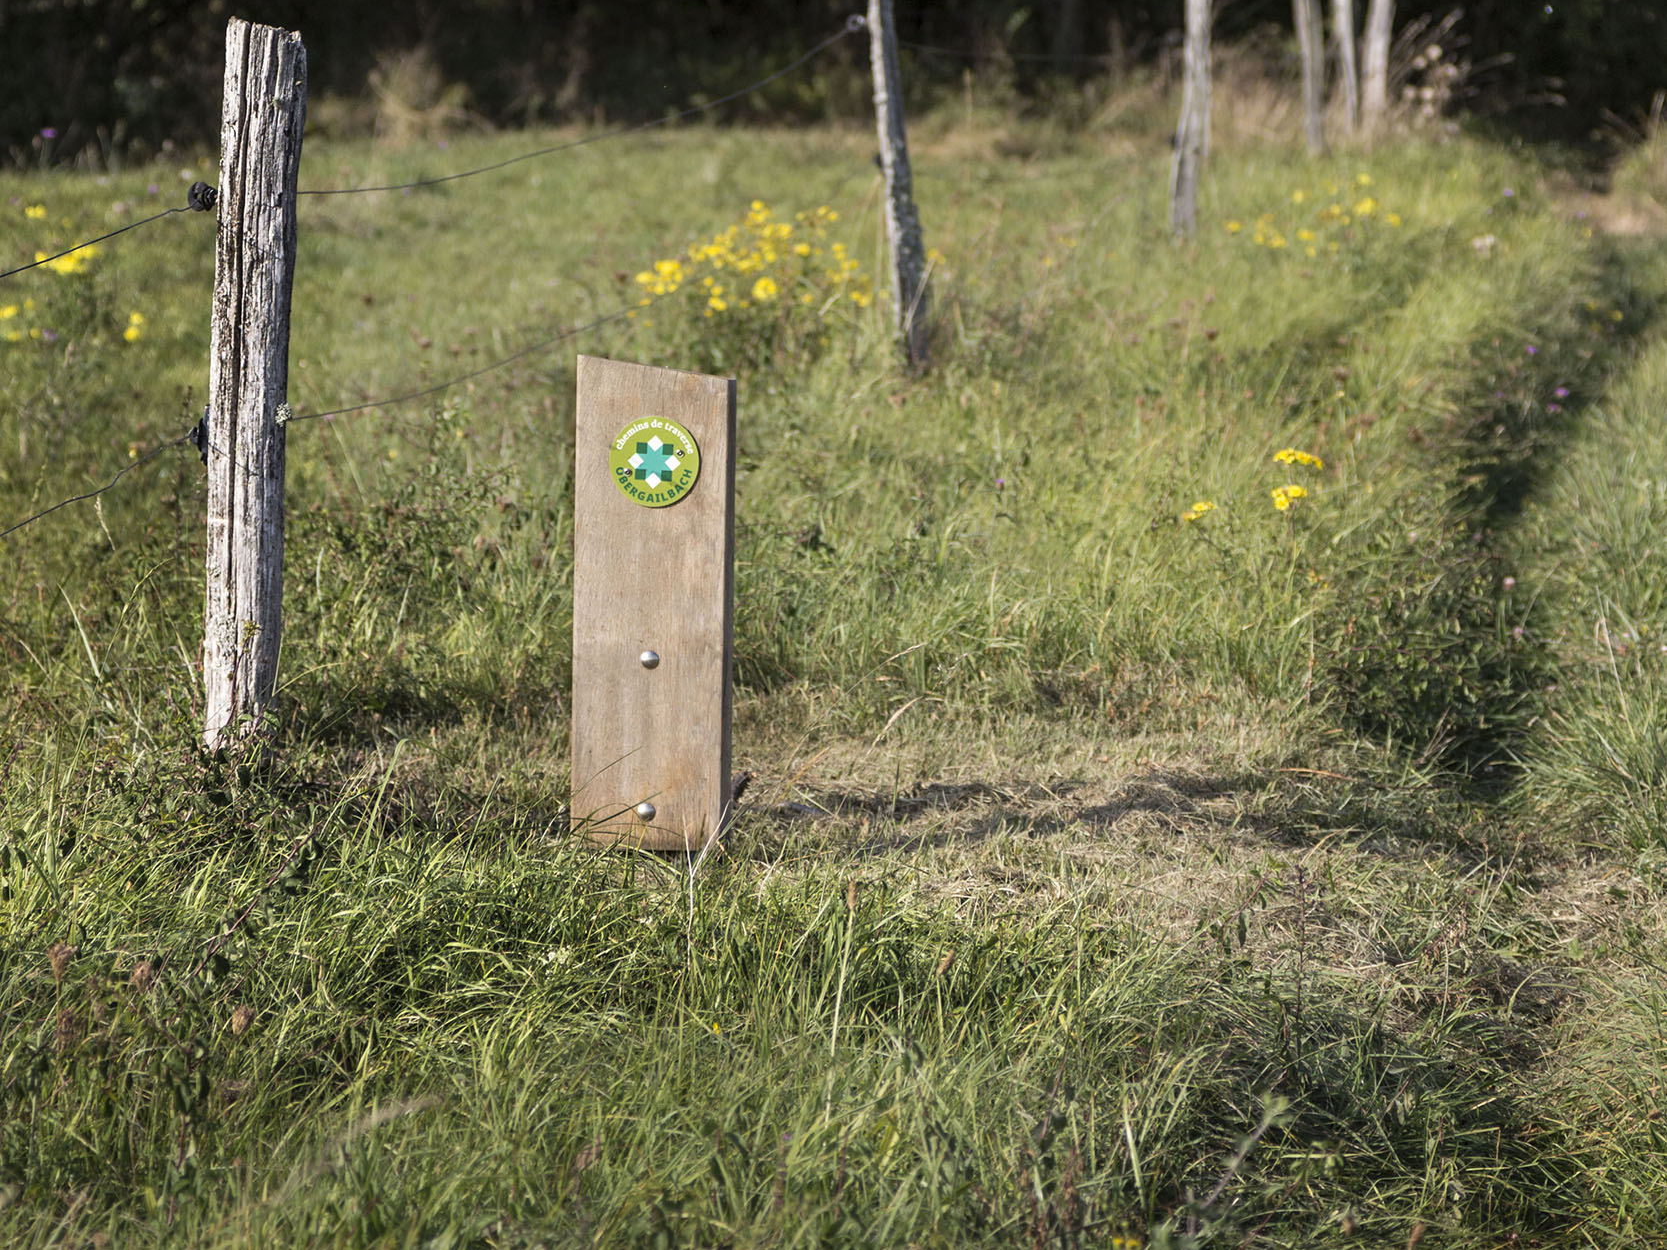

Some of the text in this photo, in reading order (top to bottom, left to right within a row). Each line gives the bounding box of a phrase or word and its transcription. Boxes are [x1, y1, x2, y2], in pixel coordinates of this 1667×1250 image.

[615, 419, 694, 454] chemins de traverse
[615, 466, 693, 503] OBERGAILBACH
